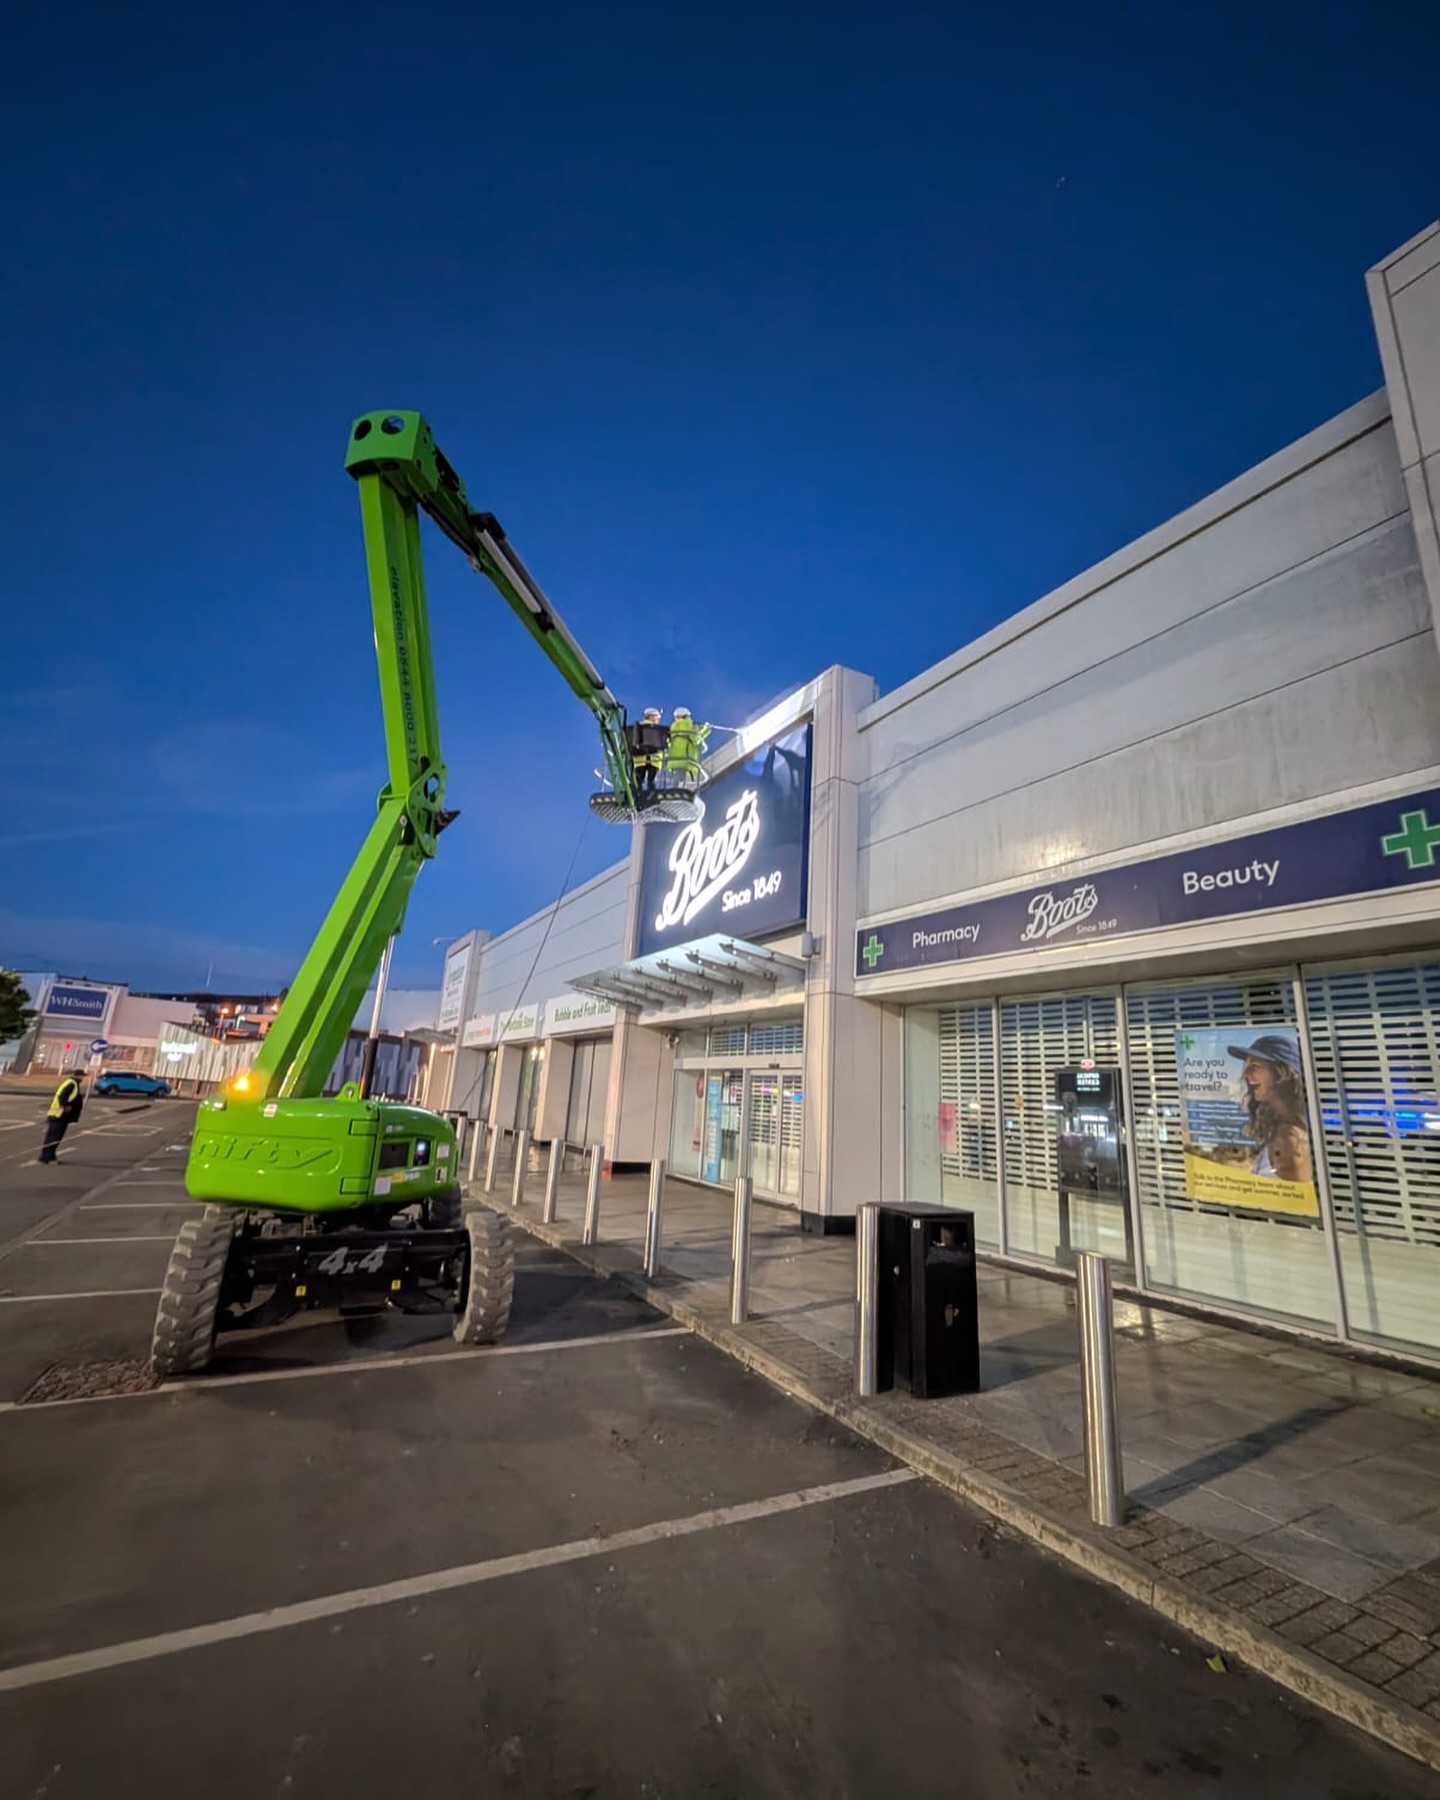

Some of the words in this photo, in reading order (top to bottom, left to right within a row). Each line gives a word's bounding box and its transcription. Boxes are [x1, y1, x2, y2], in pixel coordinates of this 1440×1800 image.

[655, 789, 760, 931] Boots
[1182, 859, 1280, 895] Beauty
[722, 889, 752, 912] Since
[753, 870, 782, 900] 1849
[1020, 884, 1098, 942] Boots
[912, 924, 980, 949] Pharmacy
[1075, 923, 1097, 935] Since
[51, 995, 103, 1010] WHSmith
[1184, 1058, 1204, 1067] Are
[1205, 1058, 1225, 1068] you
[1184, 1071, 1214, 1081] ready
[1216, 1070, 1228, 1080] to
[1185, 1082, 1222, 1092] travel?
[318, 1242, 388, 1275] 4x4
